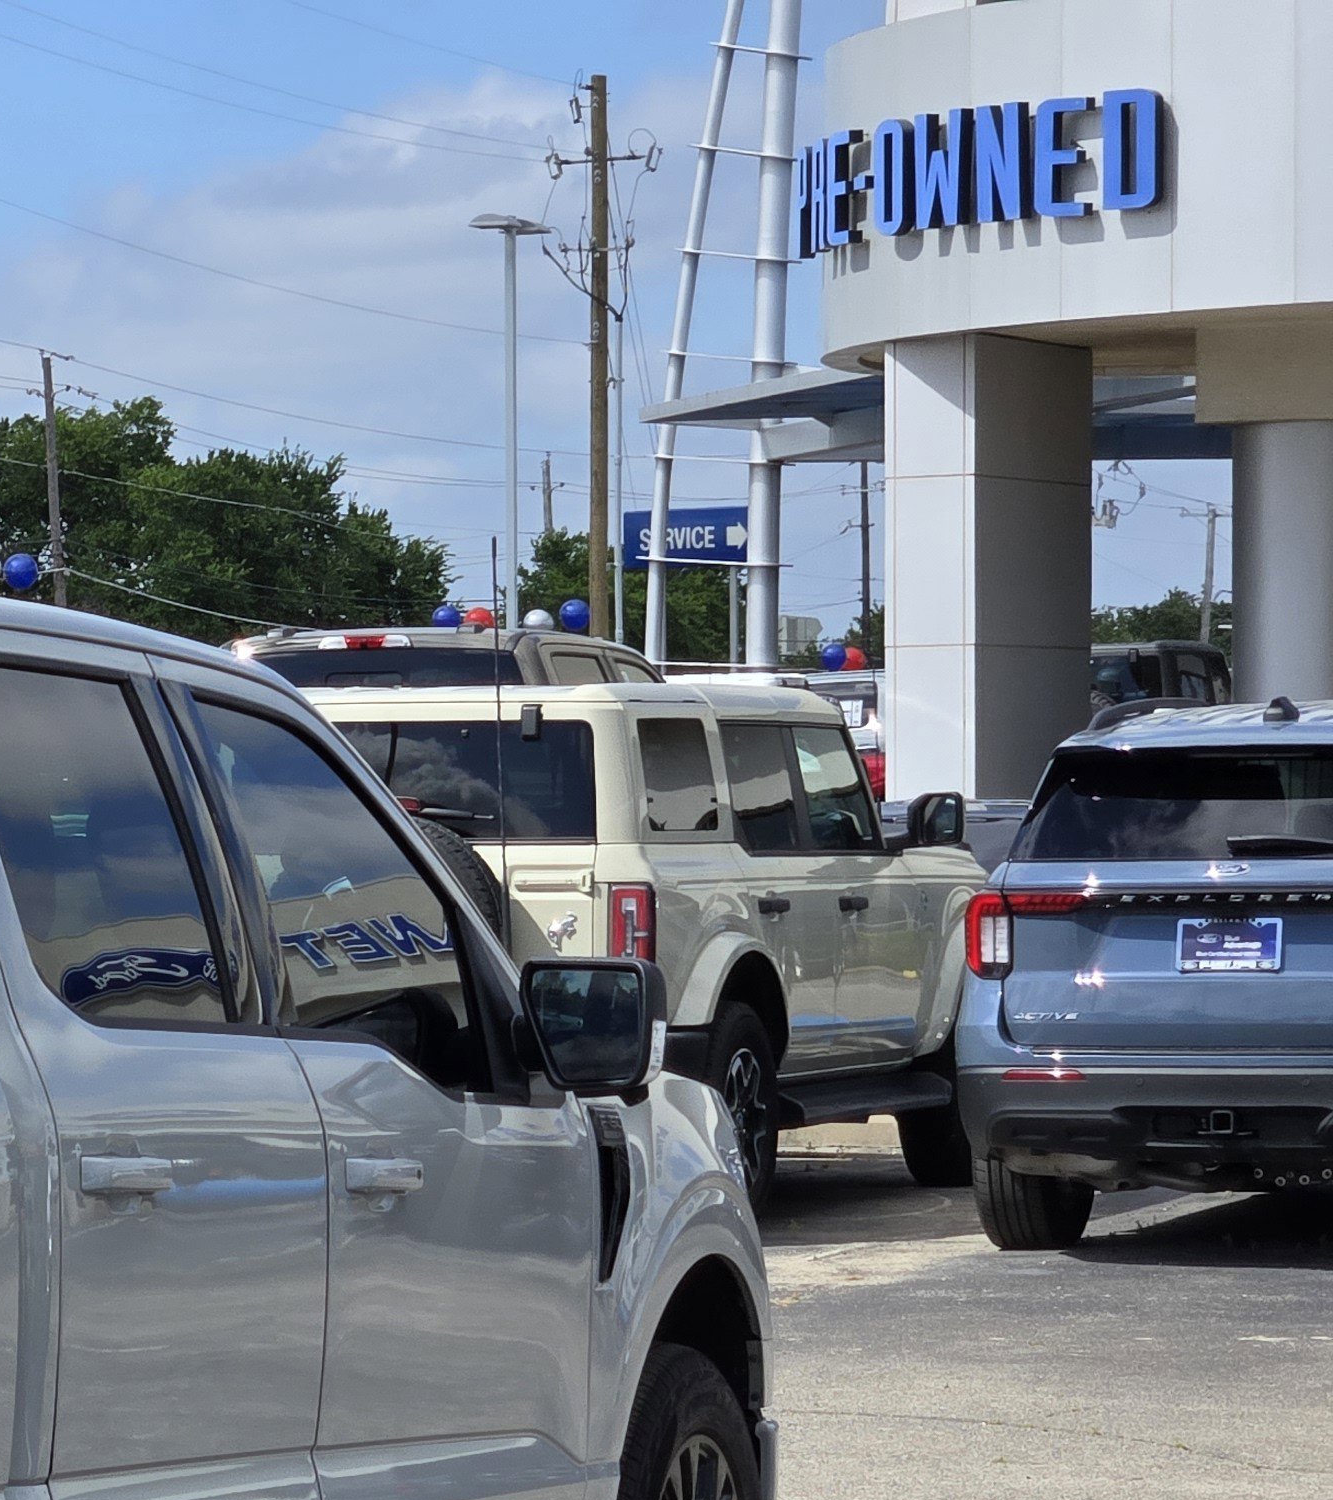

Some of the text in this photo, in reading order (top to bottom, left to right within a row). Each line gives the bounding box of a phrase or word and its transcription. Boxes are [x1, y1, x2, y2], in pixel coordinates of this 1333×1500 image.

[796, 88, 1163, 259] PRE-OWNED
[639, 525, 716, 552] SRVICE
[1119, 893, 1331, 903] EXPLORER
